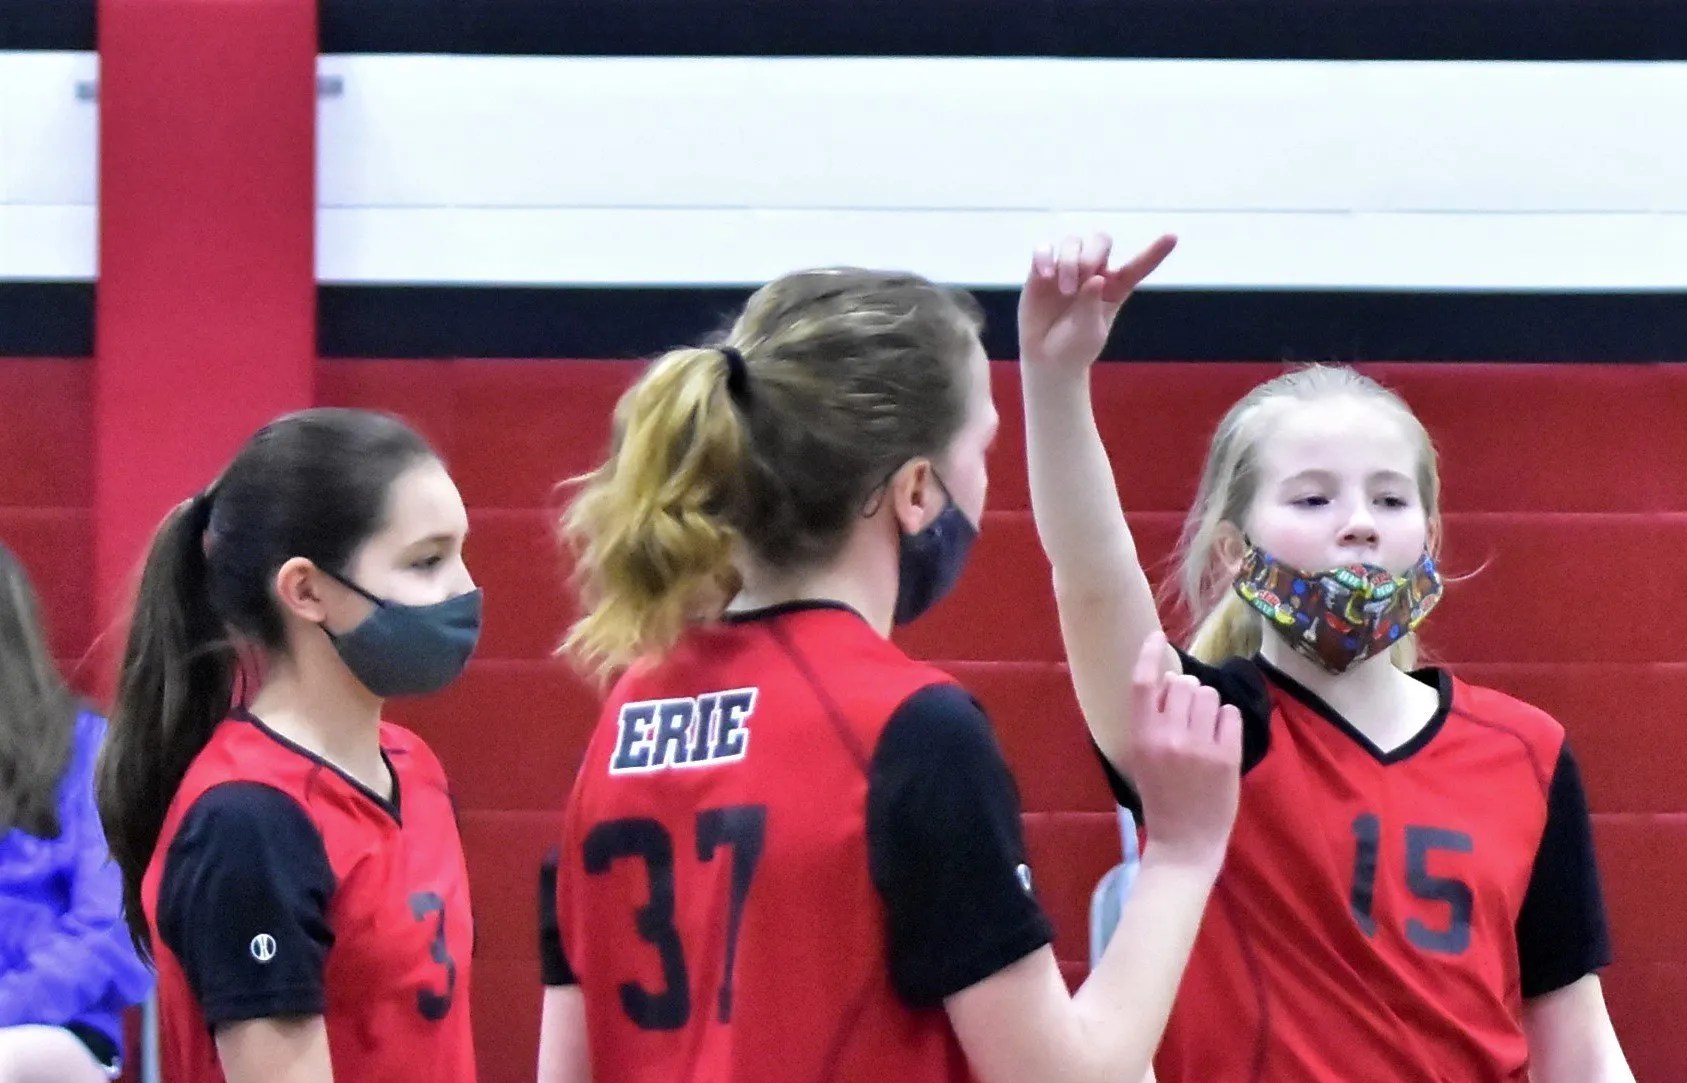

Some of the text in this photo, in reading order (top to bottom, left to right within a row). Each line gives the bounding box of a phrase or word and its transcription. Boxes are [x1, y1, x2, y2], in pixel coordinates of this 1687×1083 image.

[609, 687, 758, 775] ERIE
[583, 804, 767, 1031] 37
[1352, 813, 1474, 956] 15
[408, 891, 456, 1021] 3
